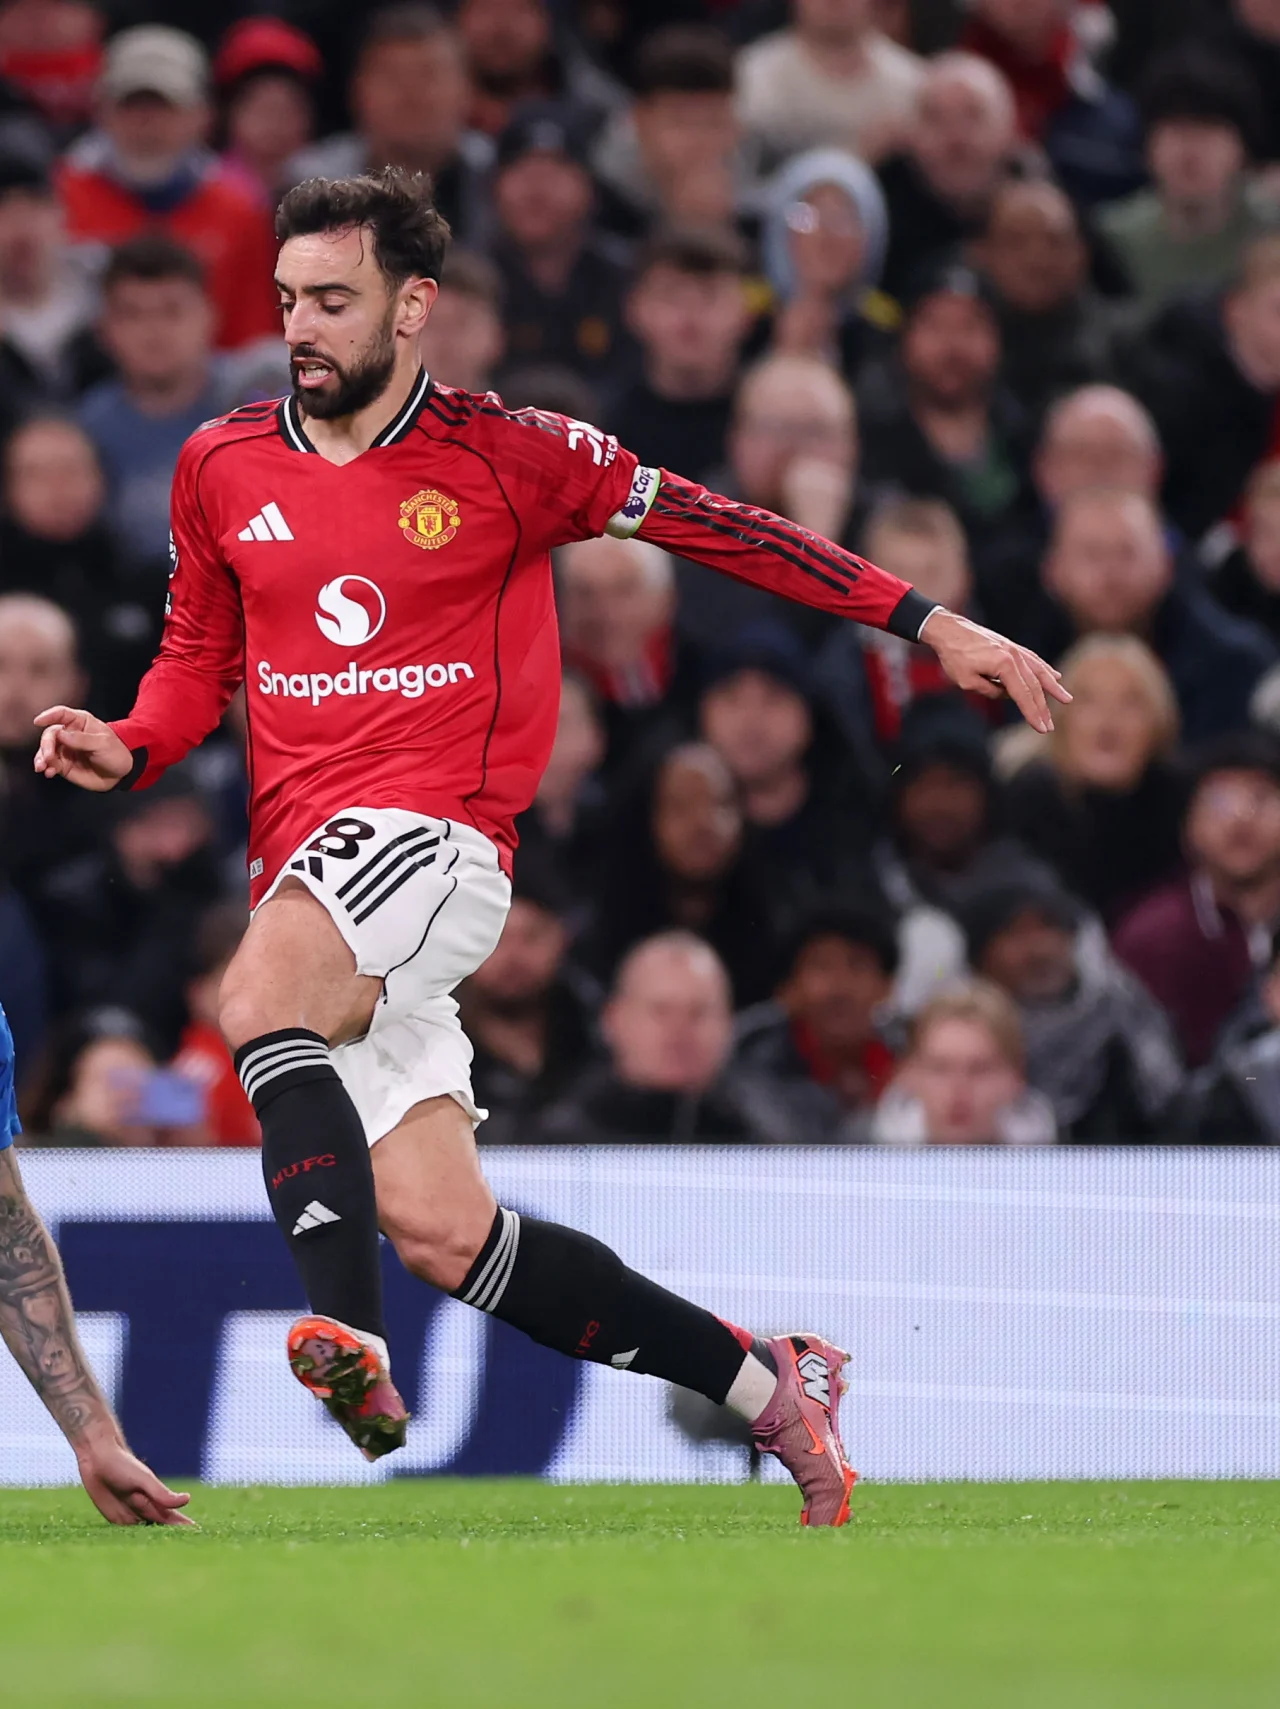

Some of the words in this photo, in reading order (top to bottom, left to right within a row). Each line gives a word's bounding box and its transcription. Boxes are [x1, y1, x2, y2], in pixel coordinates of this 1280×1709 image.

[632, 467, 655, 494] Cap
[404, 492, 455, 514] MANCHESTER
[412, 533, 449, 547] UNITED
[257, 660, 475, 707] Snapdragon
[305, 817, 376, 860] 8
[271, 1152, 337, 1190] MUFC
